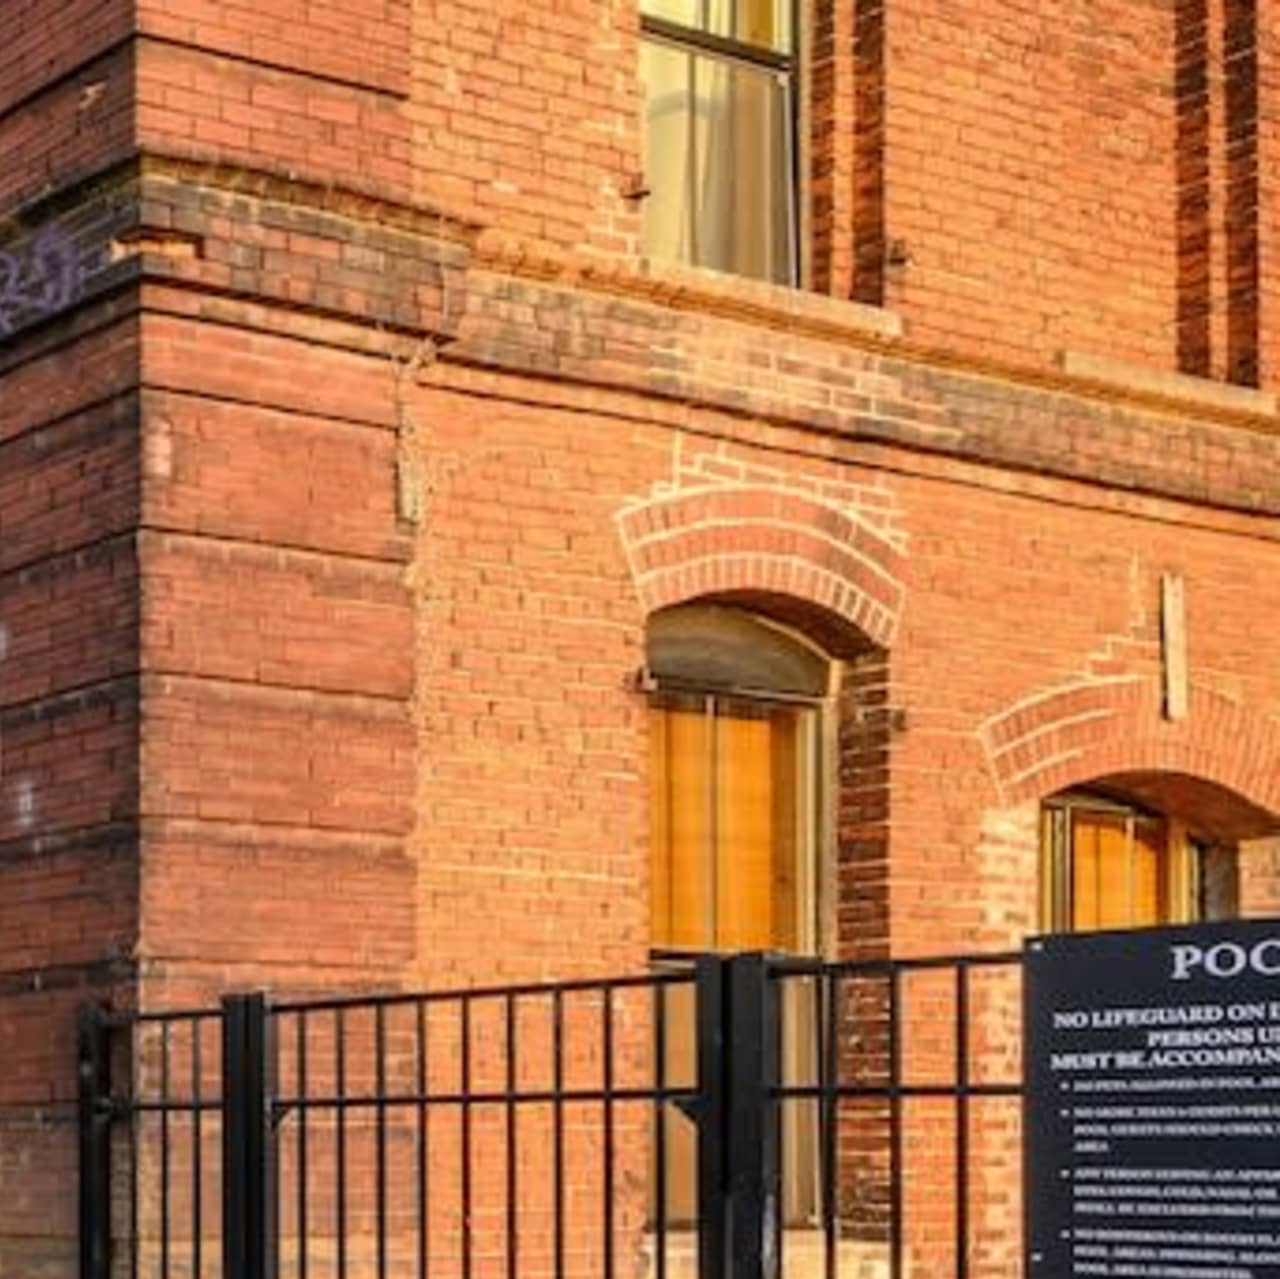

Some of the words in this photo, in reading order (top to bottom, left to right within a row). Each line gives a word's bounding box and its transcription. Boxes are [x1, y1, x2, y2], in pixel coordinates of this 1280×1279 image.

[1054, 1012, 1088, 1029] NO
[1093, 1005, 1224, 1027] LIFEGUARD
[1228, 1004, 1265, 1020] ON
[1148, 1028, 1254, 1047] PERSONS
[1051, 1053, 1112, 1070] MUST
